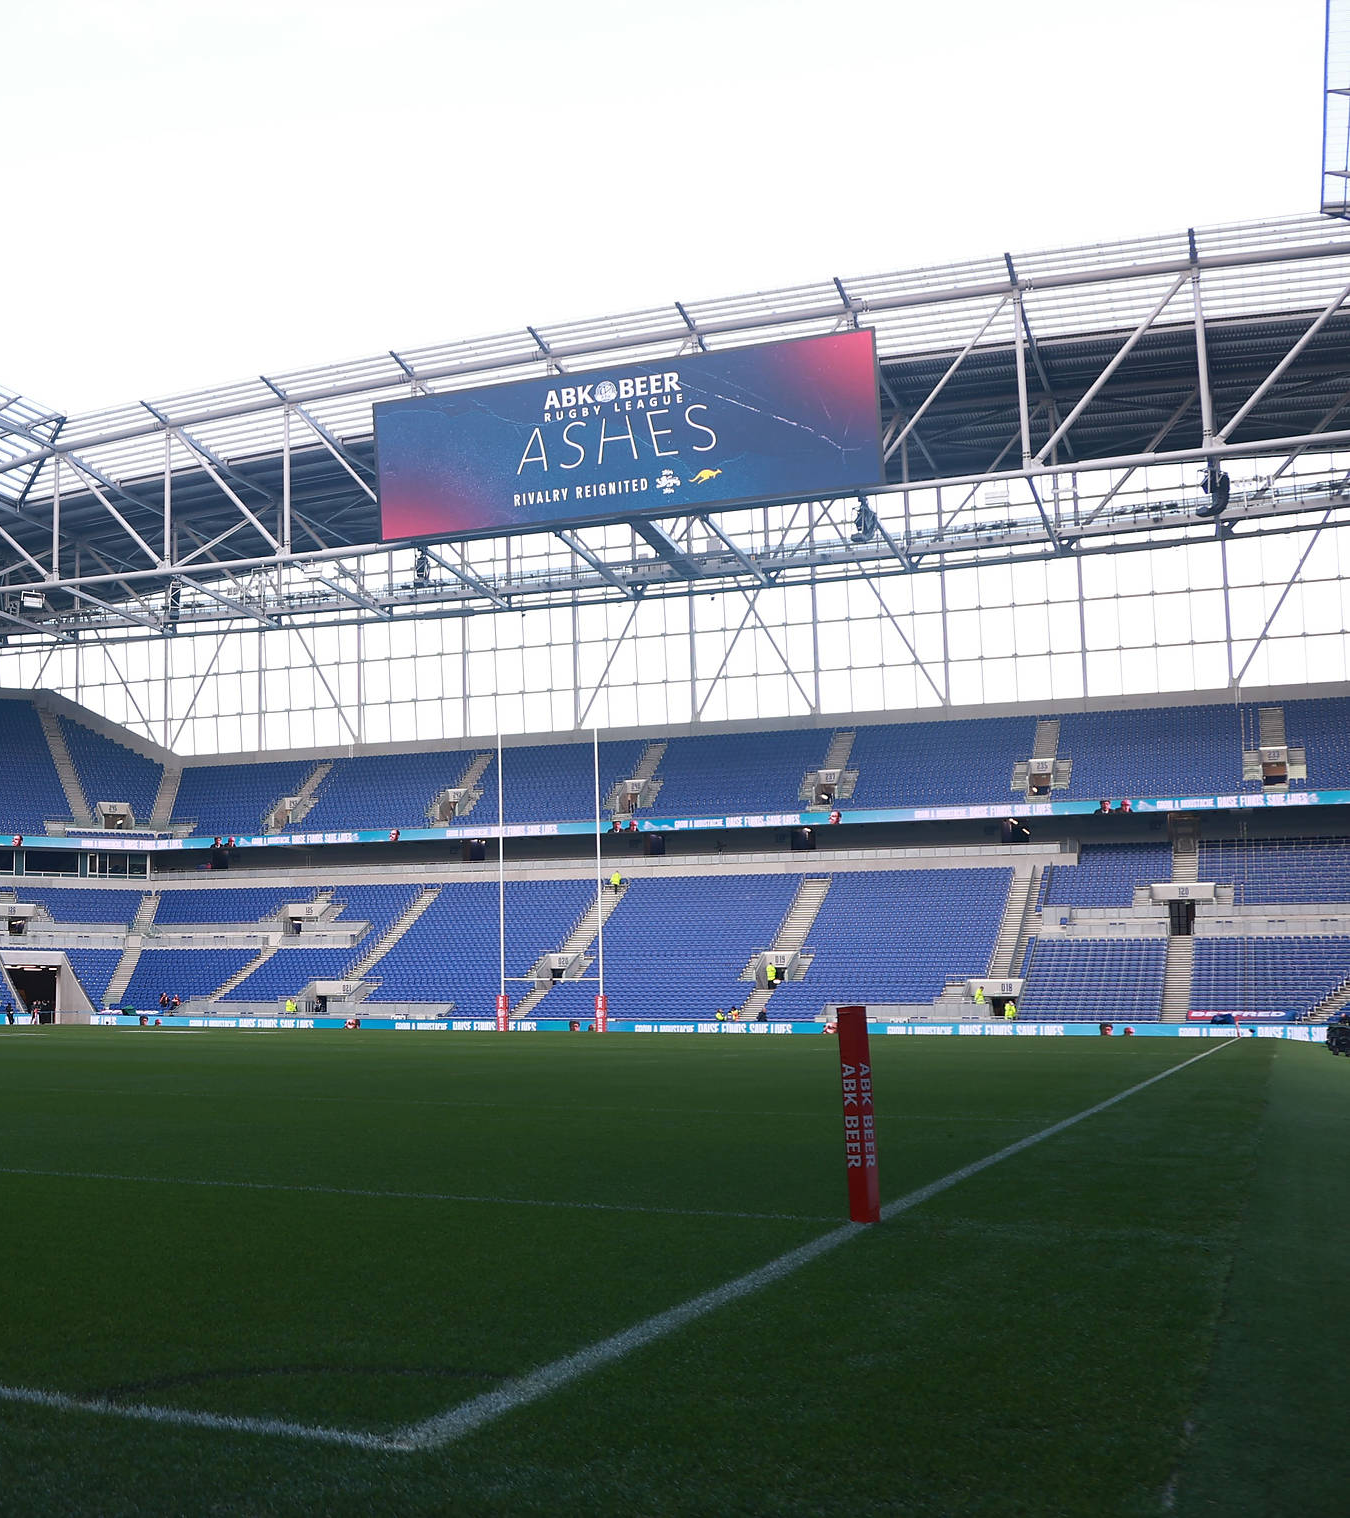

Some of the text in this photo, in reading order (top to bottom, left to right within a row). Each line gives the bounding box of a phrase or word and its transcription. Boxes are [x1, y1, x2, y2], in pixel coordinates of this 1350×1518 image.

[544, 372, 681, 410] ABK BEER
[544, 393, 683, 422] RUGBY LEAGUE
[517, 404, 717, 475] ASHES
[514, 477, 648, 507] RIVALRY REIGNITED
[1178, 887, 1190, 895] 120
[1001, 983, 1013, 992] 018
[842, 1063, 862, 1169] ABK BEER
[859, 1062, 876, 1168] ABK BEER
